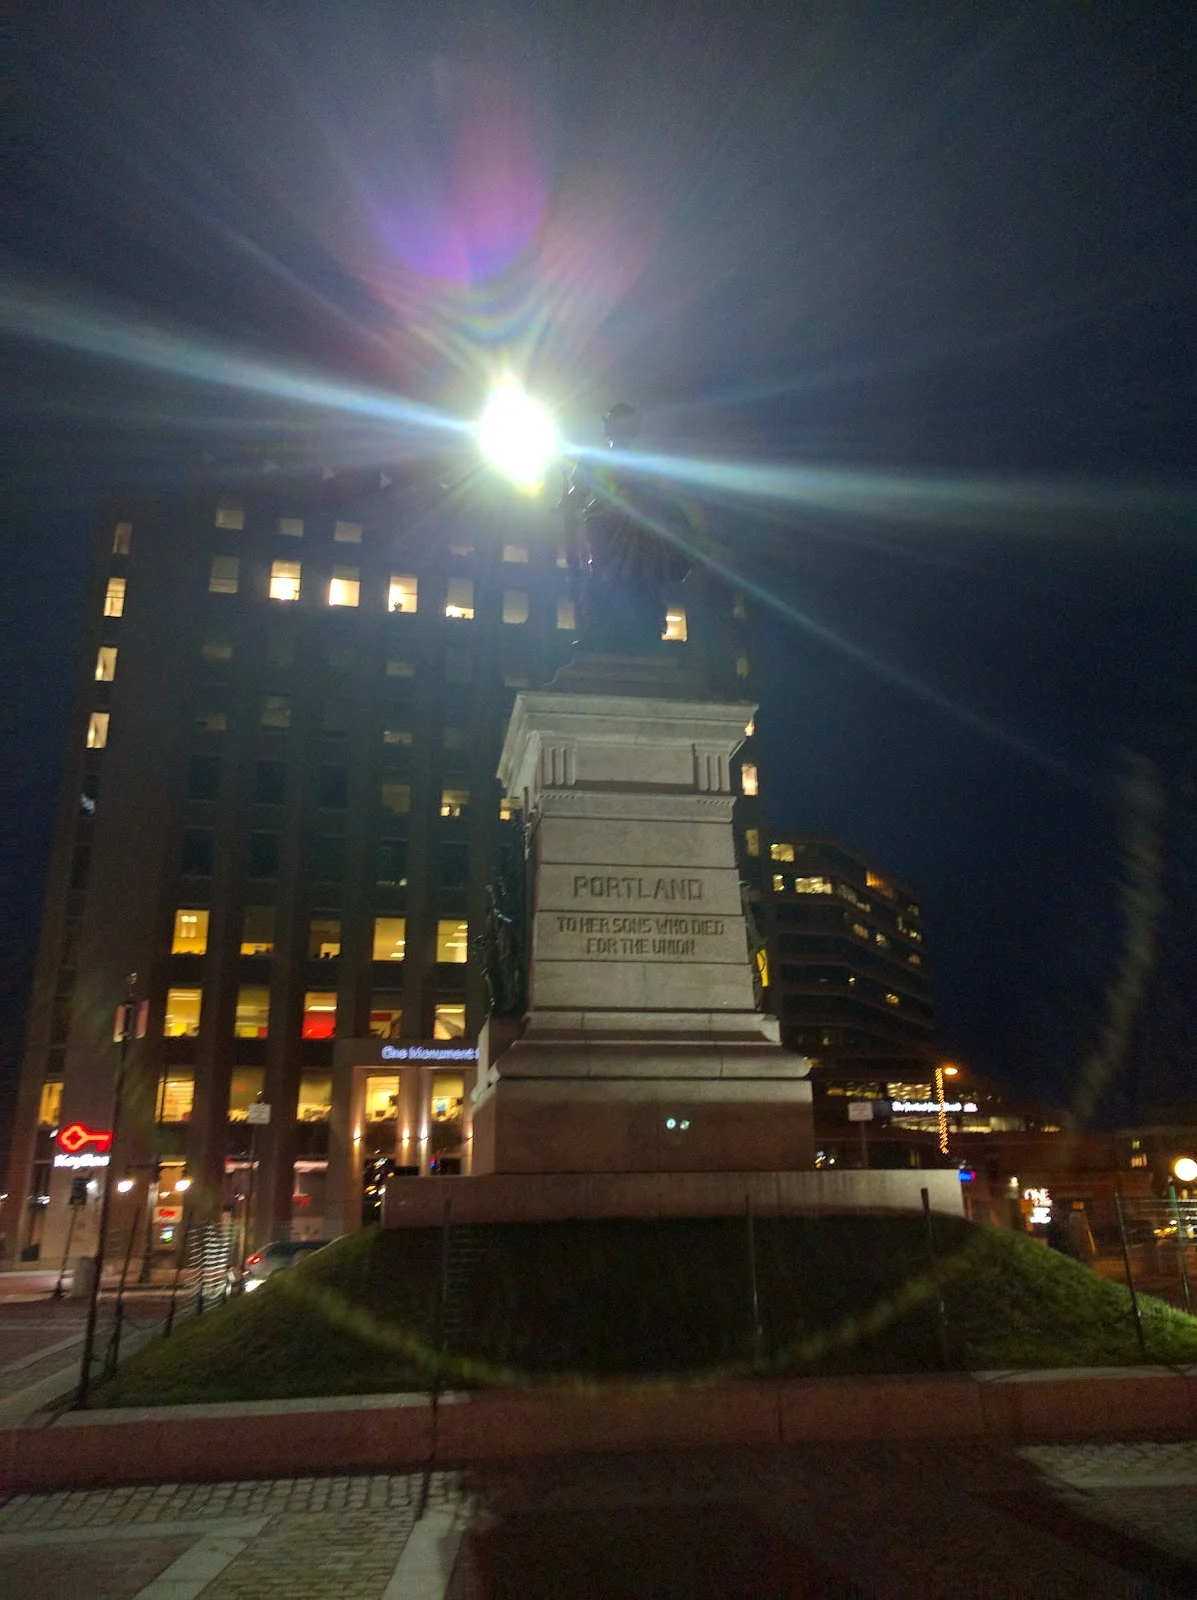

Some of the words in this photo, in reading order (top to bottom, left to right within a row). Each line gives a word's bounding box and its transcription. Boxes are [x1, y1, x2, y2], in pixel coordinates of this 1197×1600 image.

[573, 875, 704, 901] PORTLAND
[556, 916, 577, 933] TO
[579, 916, 609, 934] HER
[612, 917, 652, 934] SONS
[655, 918, 689, 936] WHO
[691, 919, 724, 936] DIED
[586, 937, 618, 955] FOR
[620, 938, 649, 955] THE
[652, 938, 696, 956] UNION
